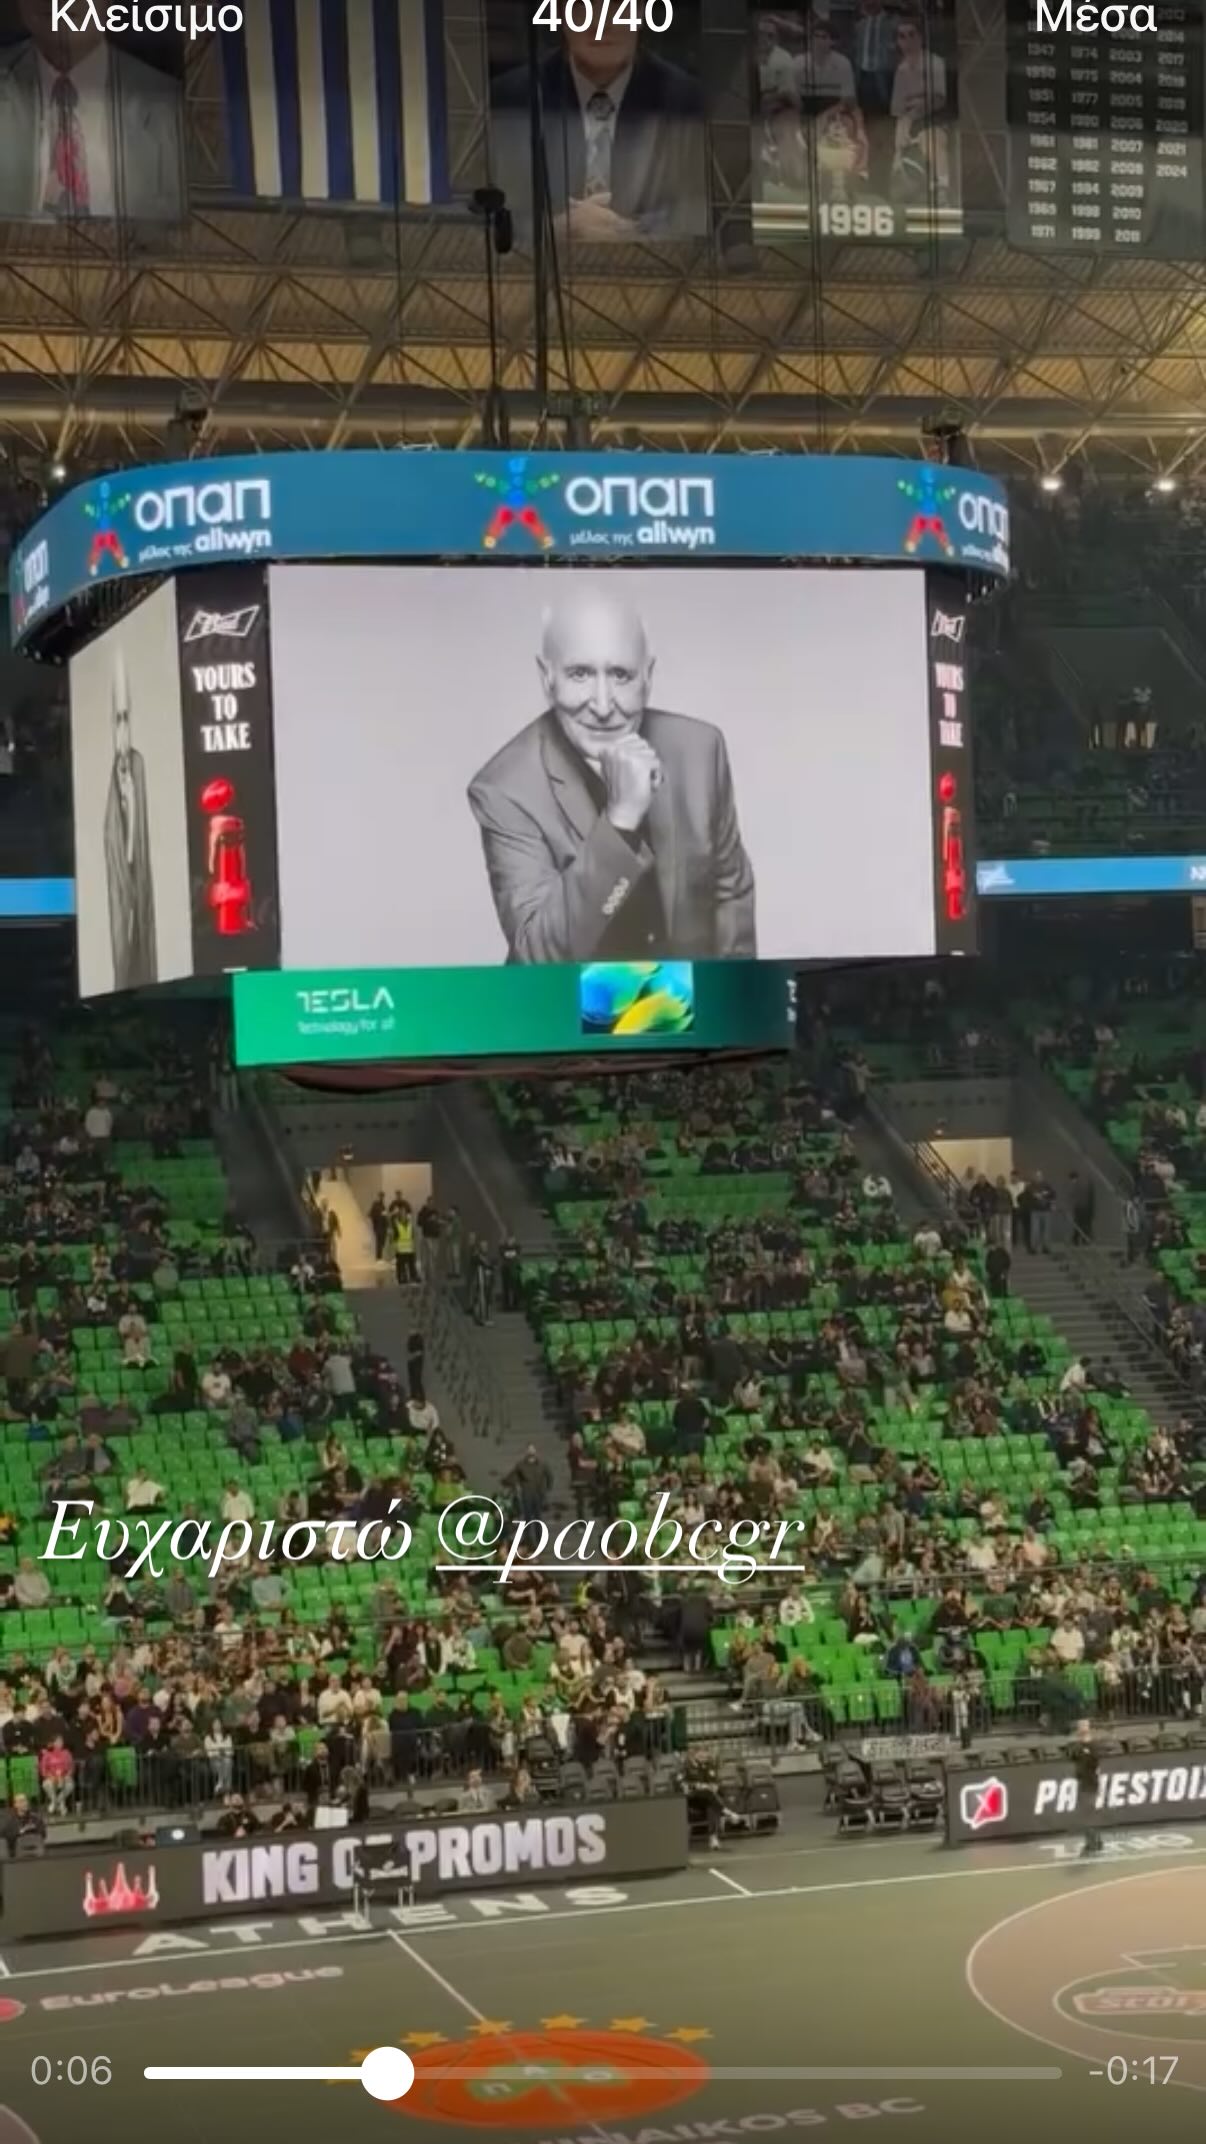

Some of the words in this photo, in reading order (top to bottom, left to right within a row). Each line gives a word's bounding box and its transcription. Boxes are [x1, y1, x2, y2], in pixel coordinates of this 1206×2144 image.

[1156, 164, 1188, 177] 2024
[819, 204, 894, 236] 1996
[194, 526, 272, 555] allwyn
[637, 520, 716, 549] allwyn
[192, 661, 256, 693] YOURS
[211, 693, 238, 721] TO
[200, 722, 252, 752] TAKE
[296, 986, 395, 1013] TESLA
[1034, 1766, 1206, 1815] PAESTOI
[202, 1841, 318, 1904] KING
[332, 1834, 393, 1889] O
[405, 1814, 607, 1882] PROMOS
[132, 1886, 628, 1955] ATHENS
[834, 2096, 926, 2120] BC
